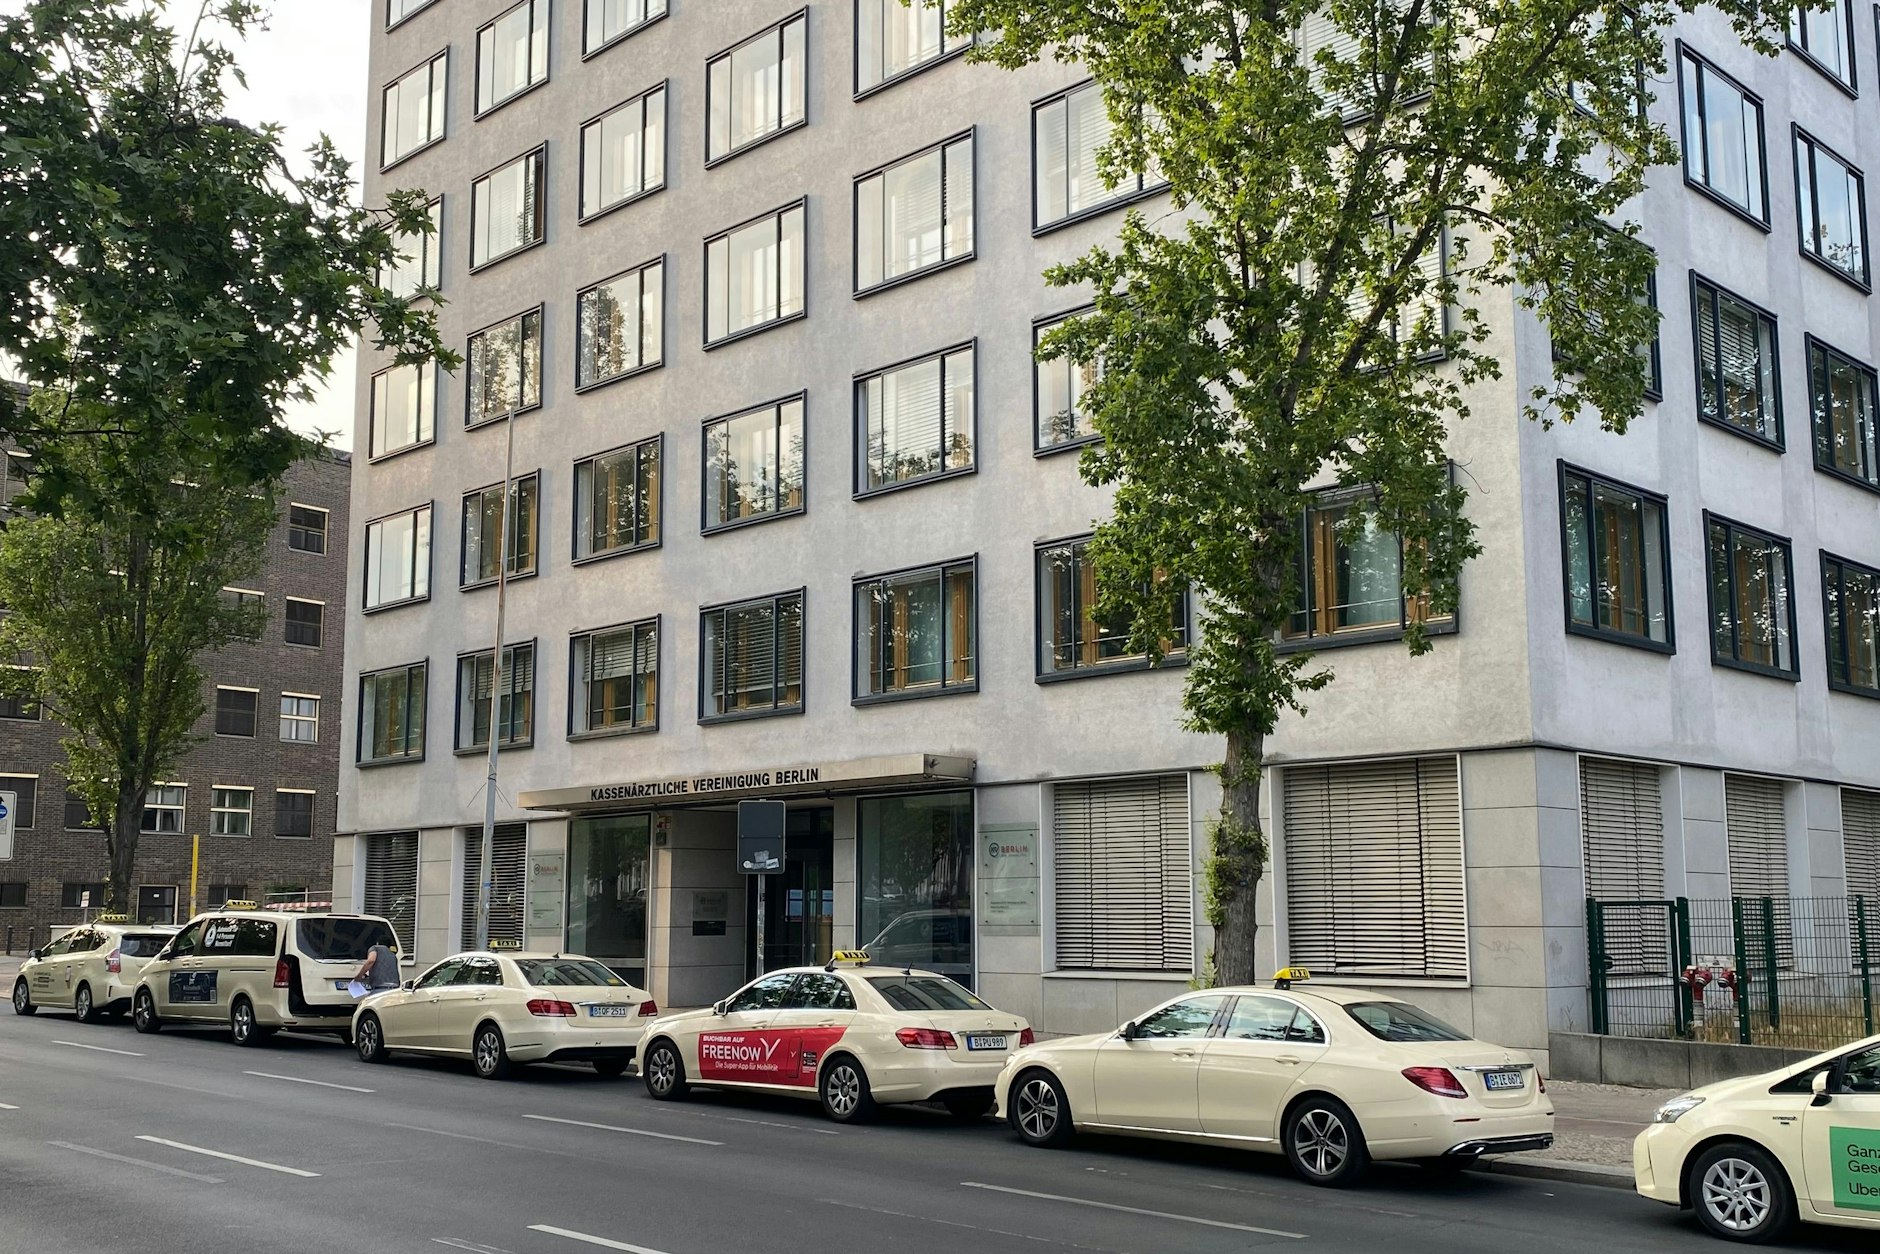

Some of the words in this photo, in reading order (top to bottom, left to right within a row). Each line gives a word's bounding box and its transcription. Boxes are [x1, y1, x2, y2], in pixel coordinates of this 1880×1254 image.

[590, 780, 689, 801] KASSENÄRZTLICHE
[692, 772, 771, 793] VEREINIGUNG
[775, 767, 819, 785] BERLIN
[1000, 845, 1028, 853] BERLIN
[1290, 969, 1308, 978] TAXI
[702, 1035, 731, 1043] BUCHBAR
[702, 1044, 762, 1061] FREENOW
[714, 1061, 724, 1069] Die
[1848, 1160, 1880, 1174] Ges
[1848, 1182, 1880, 1197] Ube
